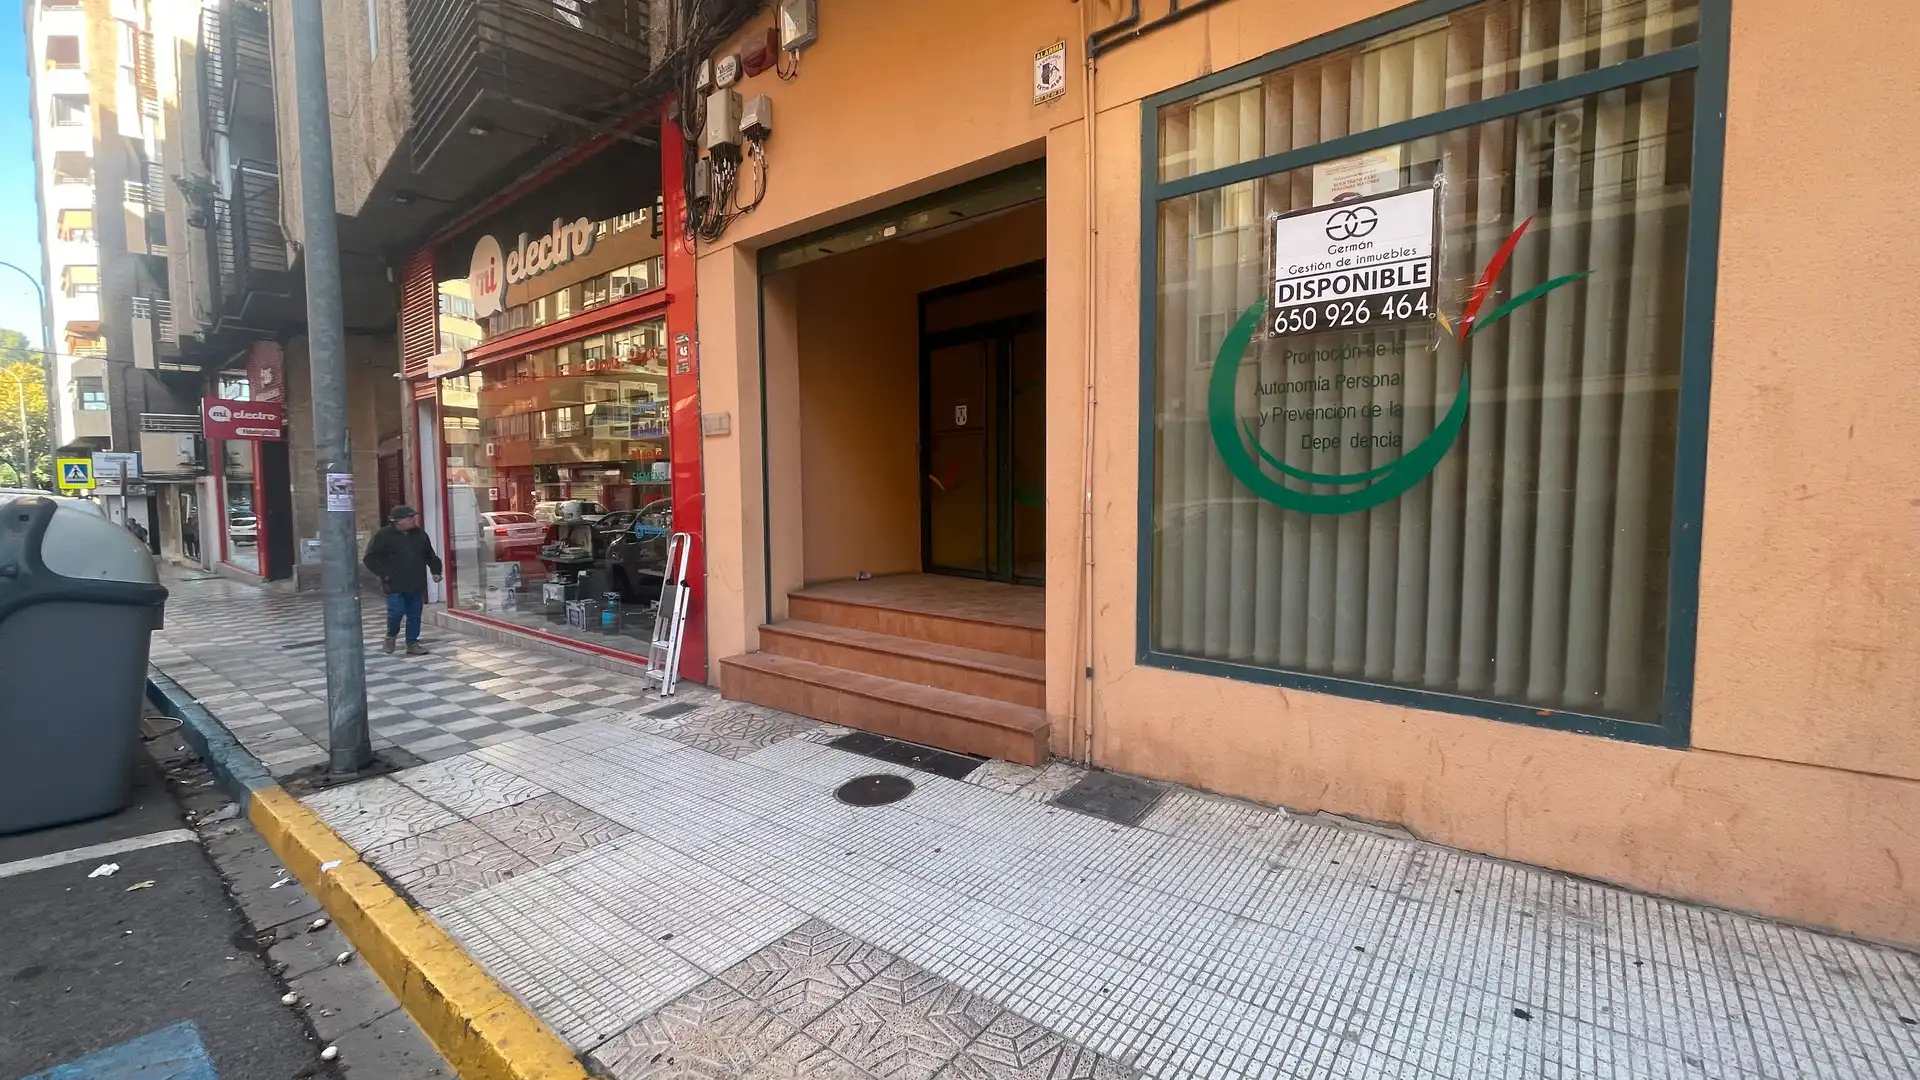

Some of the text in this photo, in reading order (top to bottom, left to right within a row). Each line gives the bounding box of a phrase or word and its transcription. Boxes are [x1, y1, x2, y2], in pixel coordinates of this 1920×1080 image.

[1036, 42, 1063, 60] ALARMA
[476, 217, 596, 296] mi electro
[1288, 247, 1417, 275] Gestión de inmuebles
[1327, 241, 1374, 255] Germán
[1278, 262, 1427, 303] DISPONIBLE
[1274, 292, 1429, 334] 650 926 464
[1284, 337, 1406, 366] Promoción de la
[1254, 375, 1330, 396] Autonomía
[212, 409, 277, 421] mi electro
[1260, 400, 1404, 427] y Prevención de la
[632, 471, 666, 483] SIEMENS
